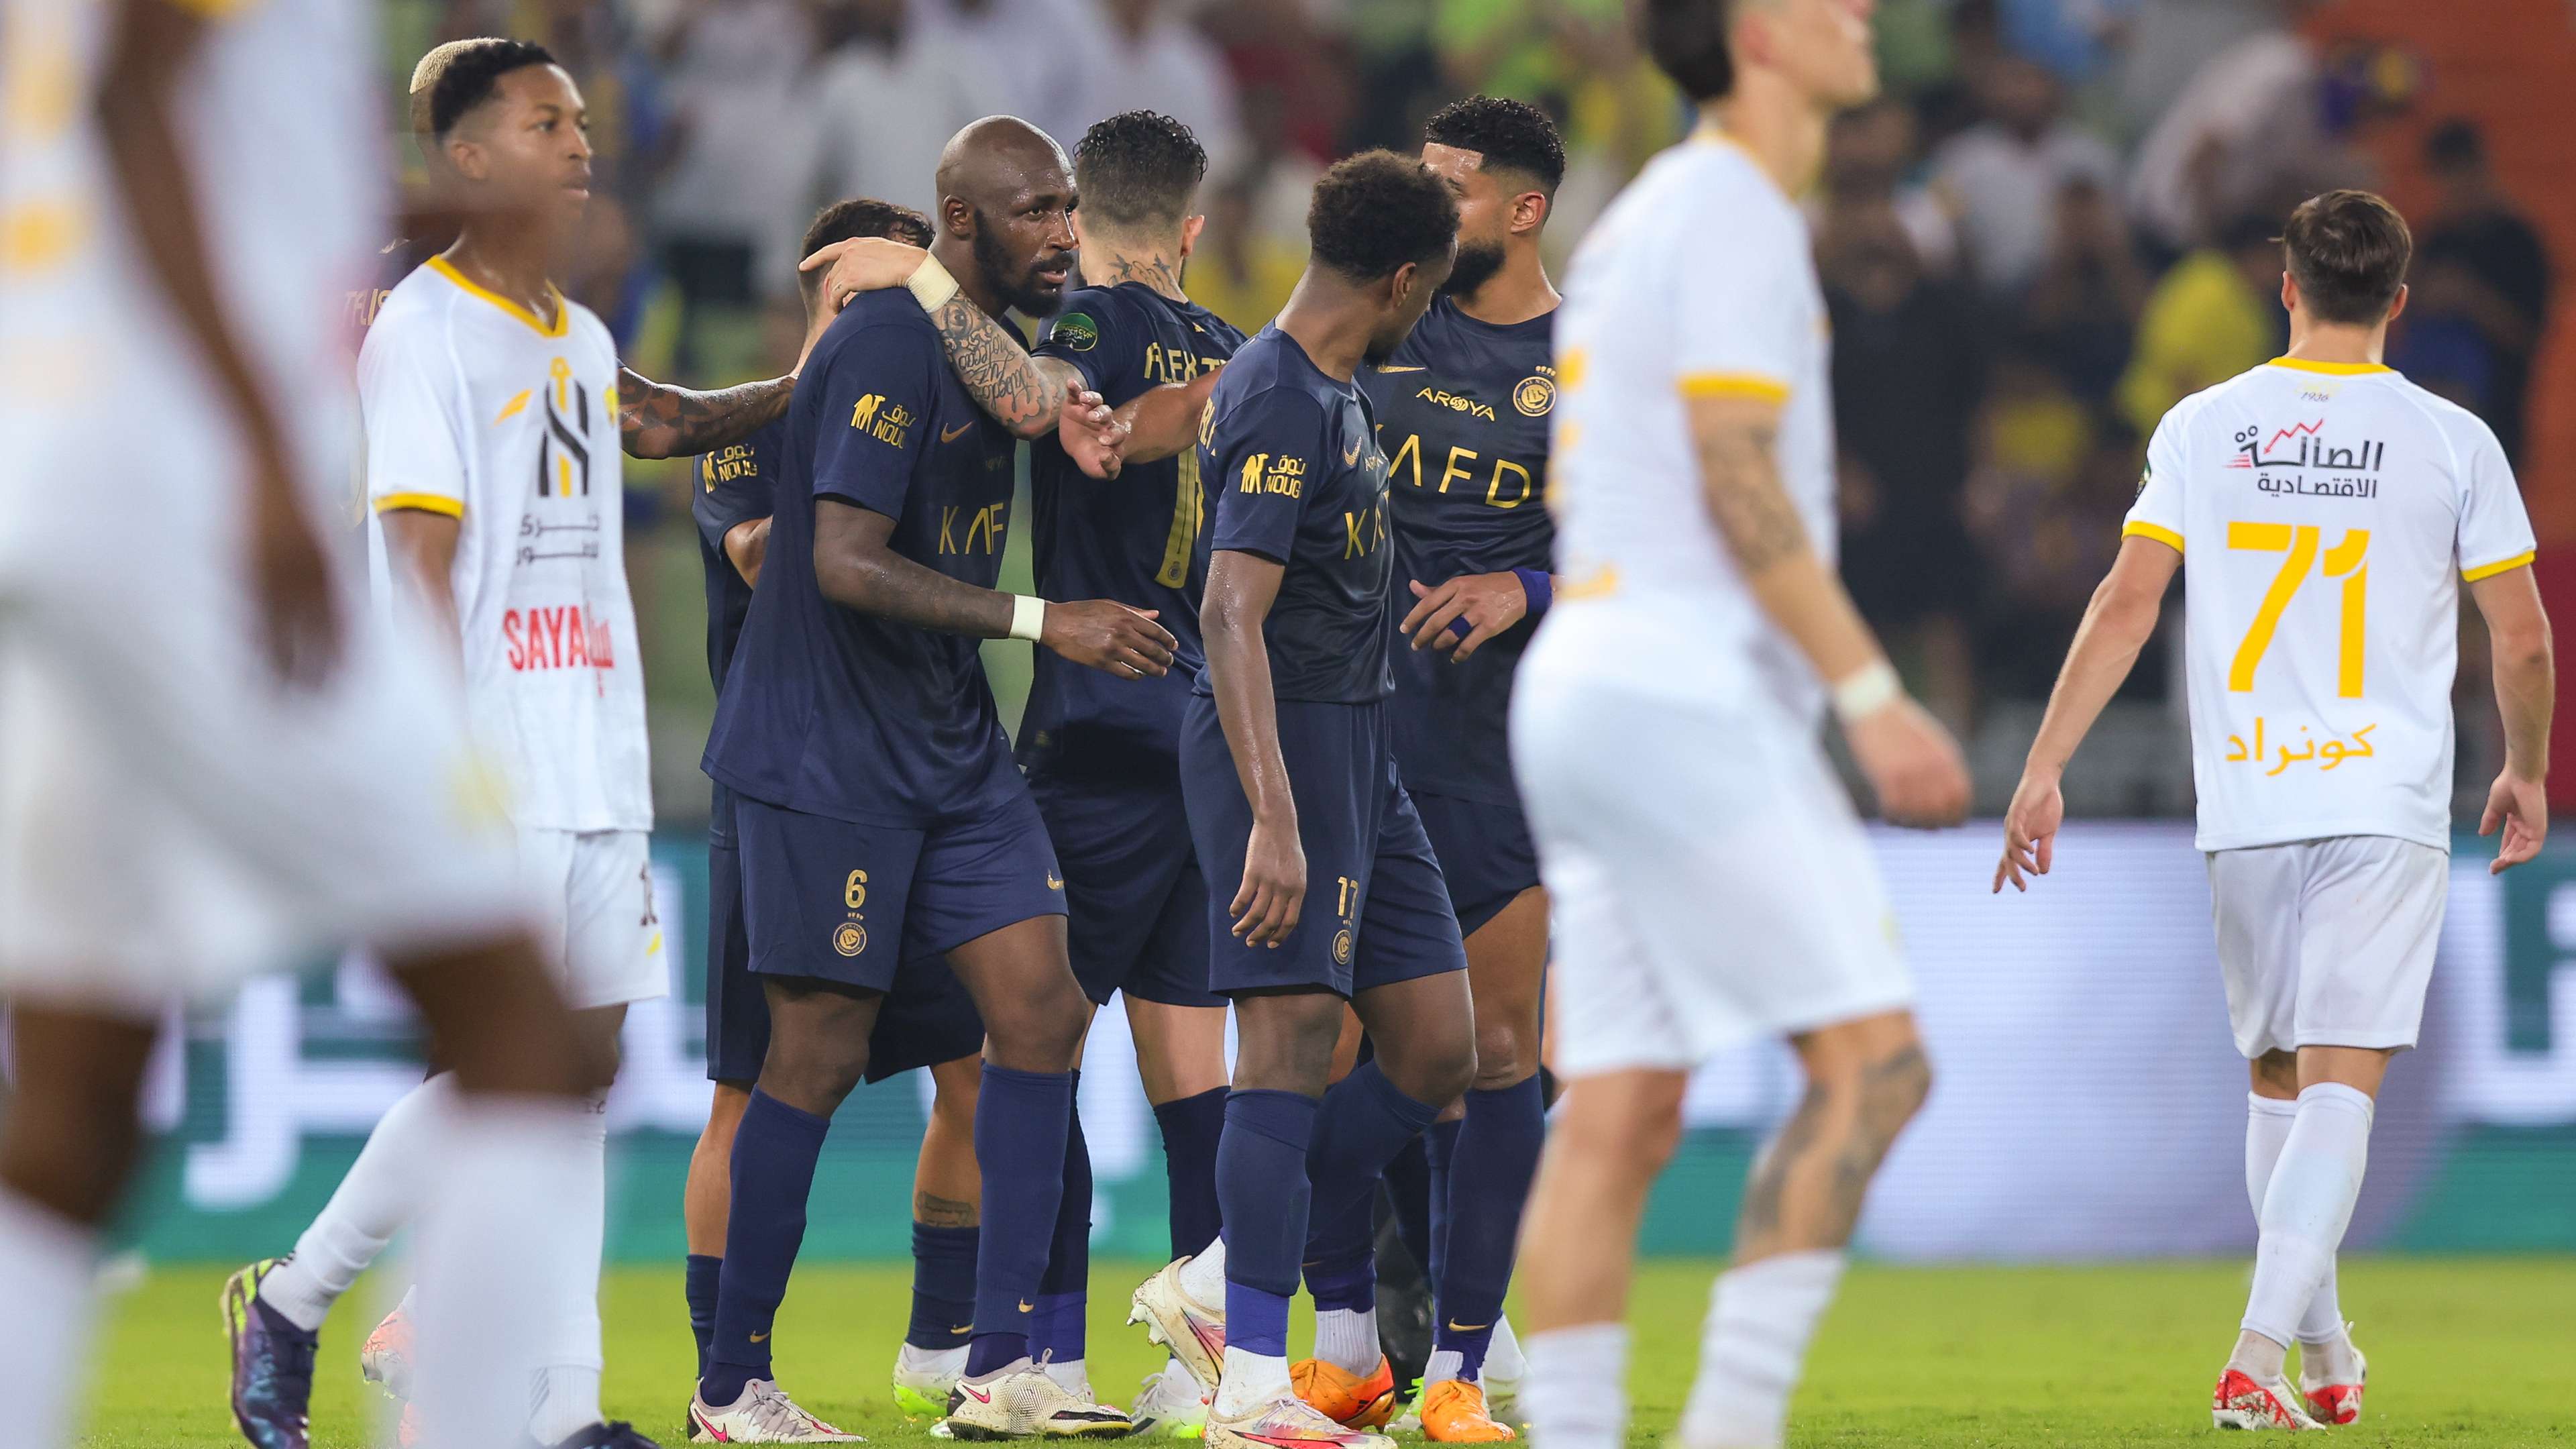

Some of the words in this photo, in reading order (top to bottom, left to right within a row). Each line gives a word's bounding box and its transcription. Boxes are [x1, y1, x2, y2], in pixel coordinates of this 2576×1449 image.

[1144, 342, 1197, 384] AEX
[1416, 387, 1495, 421] AROYA
[1265, 475, 1301, 498] NOUG
[2257, 472, 2377, 498] الاقتصادية
[2227, 521, 2370, 698] 71
[2225, 716, 2377, 777] كونراد
[845, 869, 867, 908] 6
